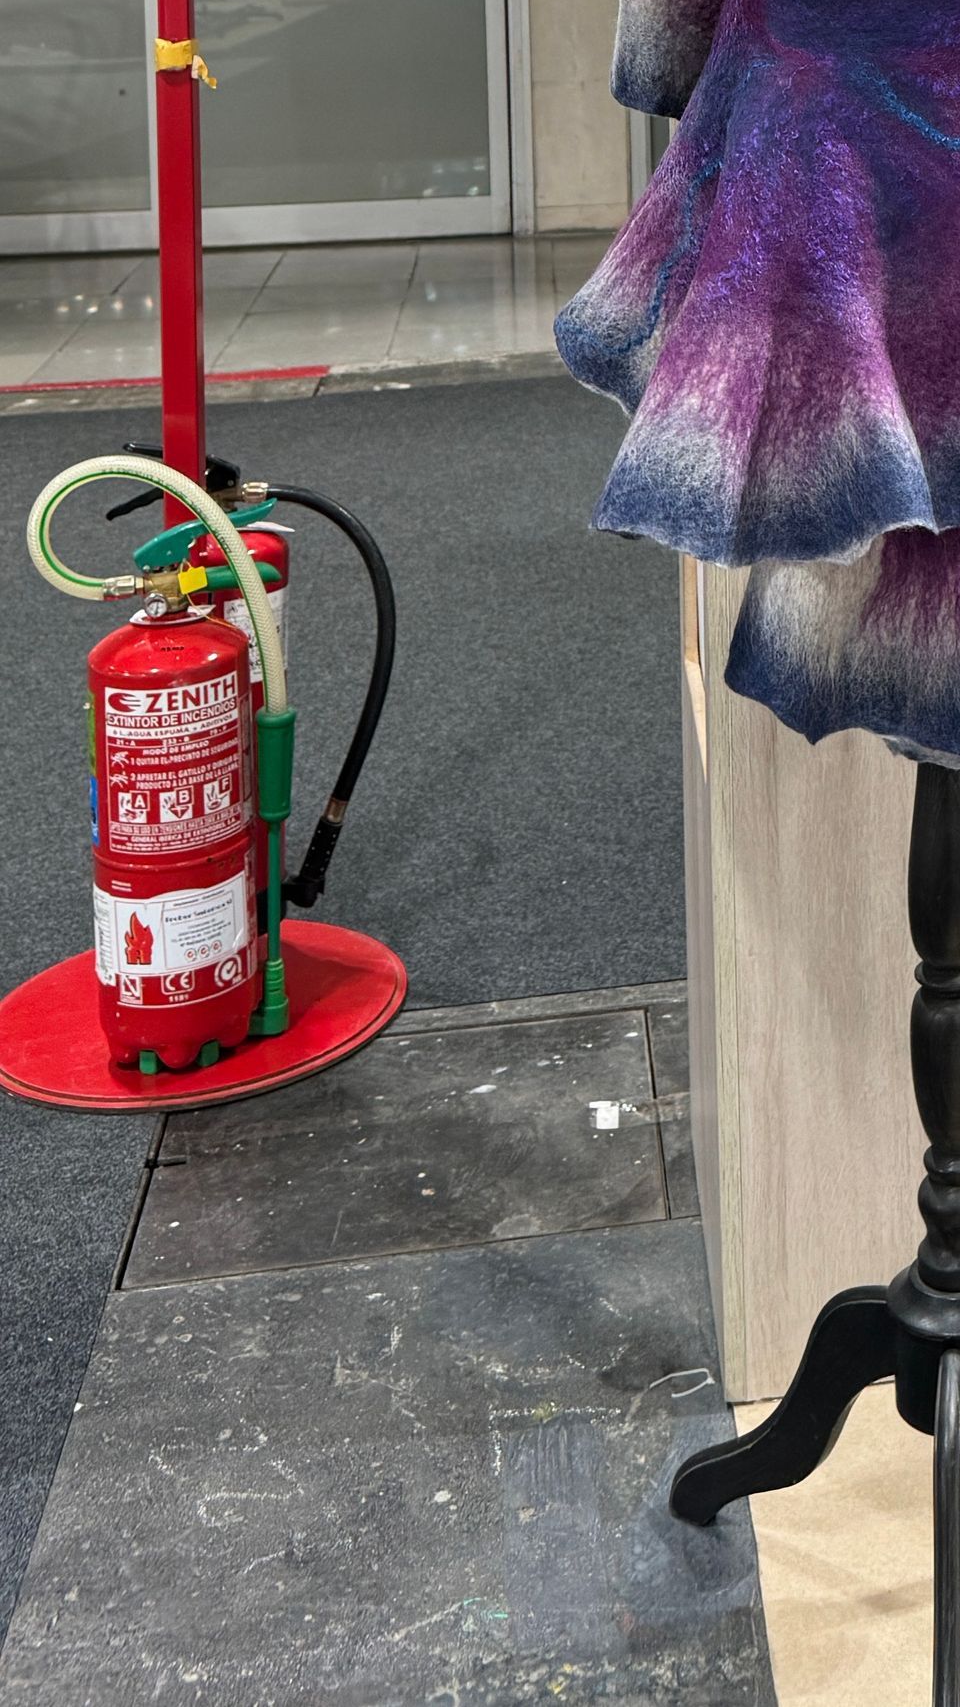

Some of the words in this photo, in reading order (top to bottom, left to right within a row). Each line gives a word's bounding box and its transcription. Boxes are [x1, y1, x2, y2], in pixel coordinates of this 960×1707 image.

[145, 675, 236, 713] ZENITH
[107, 714, 159, 728] EXTINTOR
[162, 714, 178, 726] DE
[181, 698, 236, 724] INCENDIOS
[155, 726, 189, 736] ESPUMA
[143, 747, 168, 755] MODO
[181, 740, 209, 752] EMPLEO
[131, 757, 135, 765] 1
[136, 757, 159, 766] QUITAR
[137, 772, 166, 781] APRETAR
[178, 765, 206, 778] GATILLO
[136, 780, 171, 789] PRODUCTO
[178, 778, 188, 786] LA
[188, 774, 204, 784] BASE
[221, 777, 229, 790] F
[134, 795, 146, 808] A
[179, 790, 190, 803] B
[165, 970, 190, 991] CE
